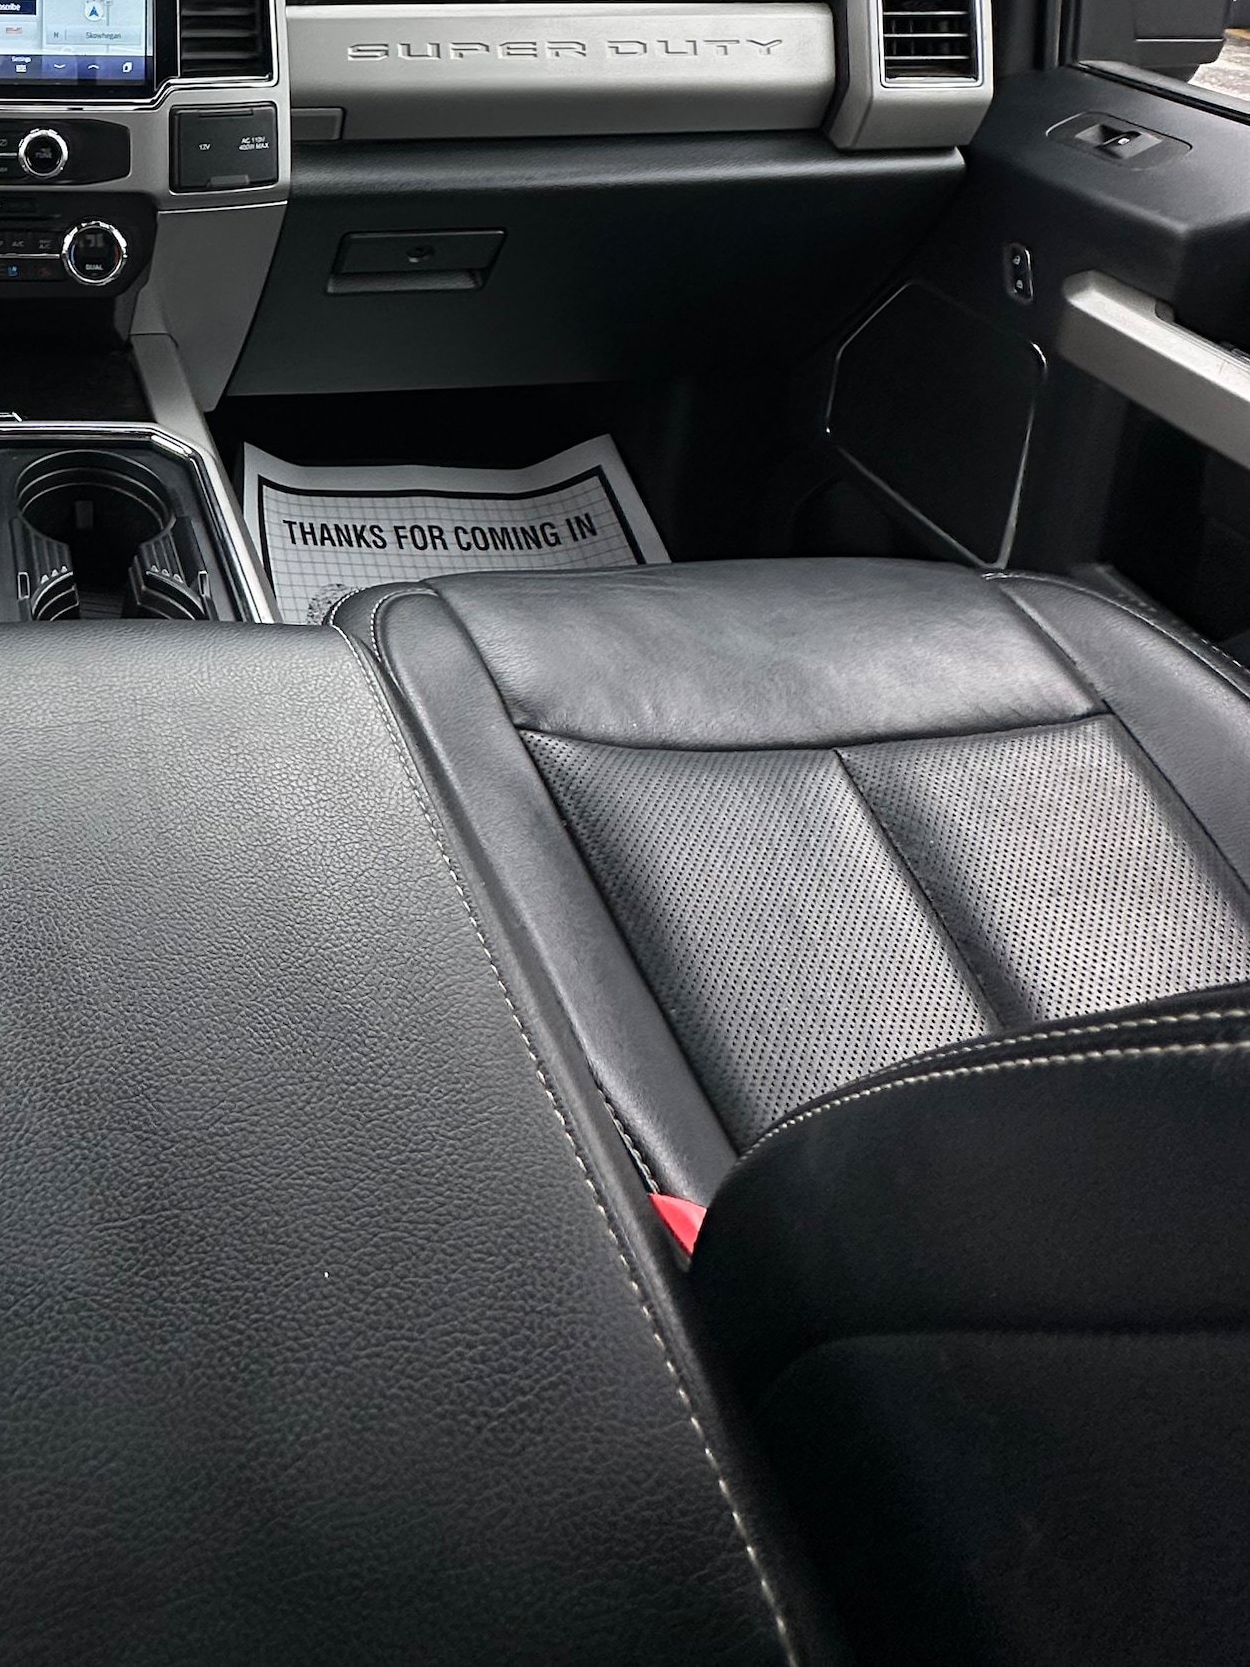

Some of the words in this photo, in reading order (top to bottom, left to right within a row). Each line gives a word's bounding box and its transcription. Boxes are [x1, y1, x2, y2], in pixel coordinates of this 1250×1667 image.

[86, 31, 121, 41] Skowhegan
[347, 41, 587, 61] SUPER
[607, 39, 783, 60] DUTY
[11, 240, 25, 248] A/C
[84, 263, 103, 271] DUAL
[282, 519, 387, 550] THANKS
[393, 524, 449, 551] FOR
[454, 521, 562, 551] COMING
[565, 512, 599, 542] IN
